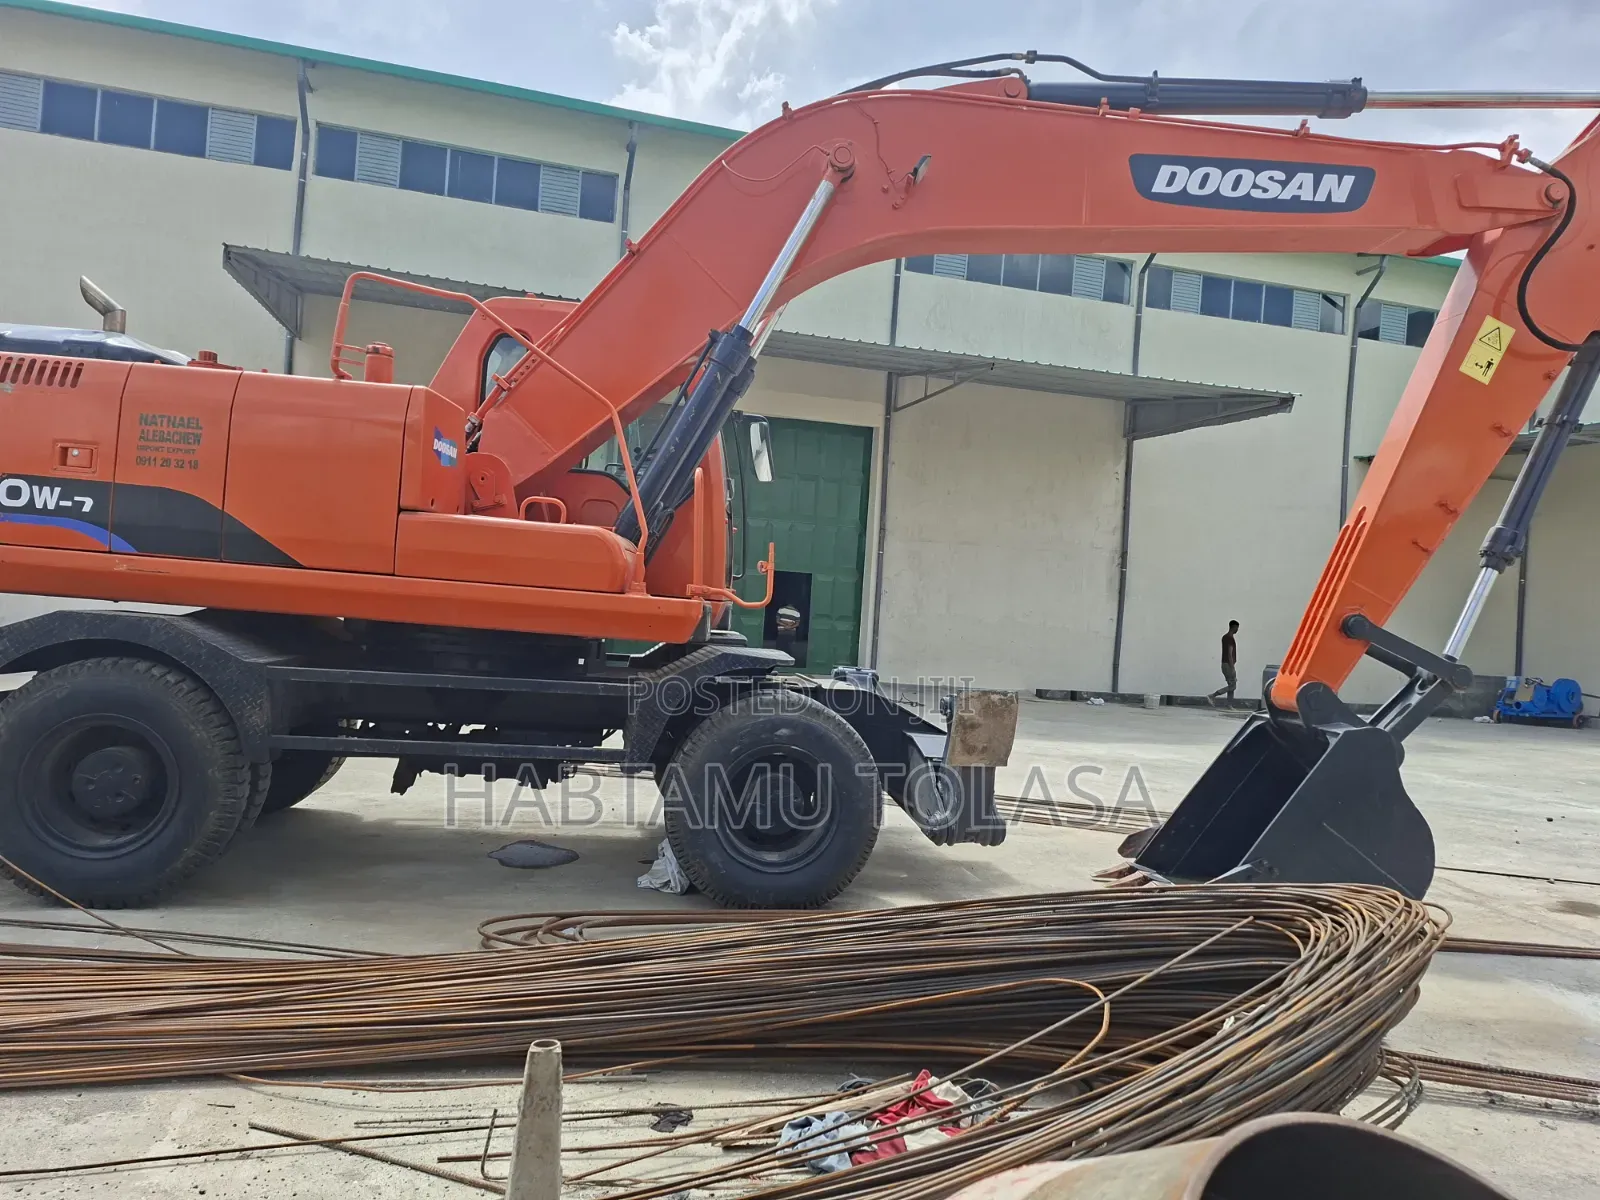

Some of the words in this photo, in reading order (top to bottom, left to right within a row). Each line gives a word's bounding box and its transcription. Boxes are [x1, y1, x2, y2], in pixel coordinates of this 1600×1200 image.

[1151, 164, 1355, 203] DOOSAN
[139, 413, 203, 430] NATNAEL
[139, 429, 202, 446] ALEBACHEW
[433, 438, 457, 459] DOOSAN
[136, 456, 156, 467] 0911
[173, 459, 185, 469] 32
